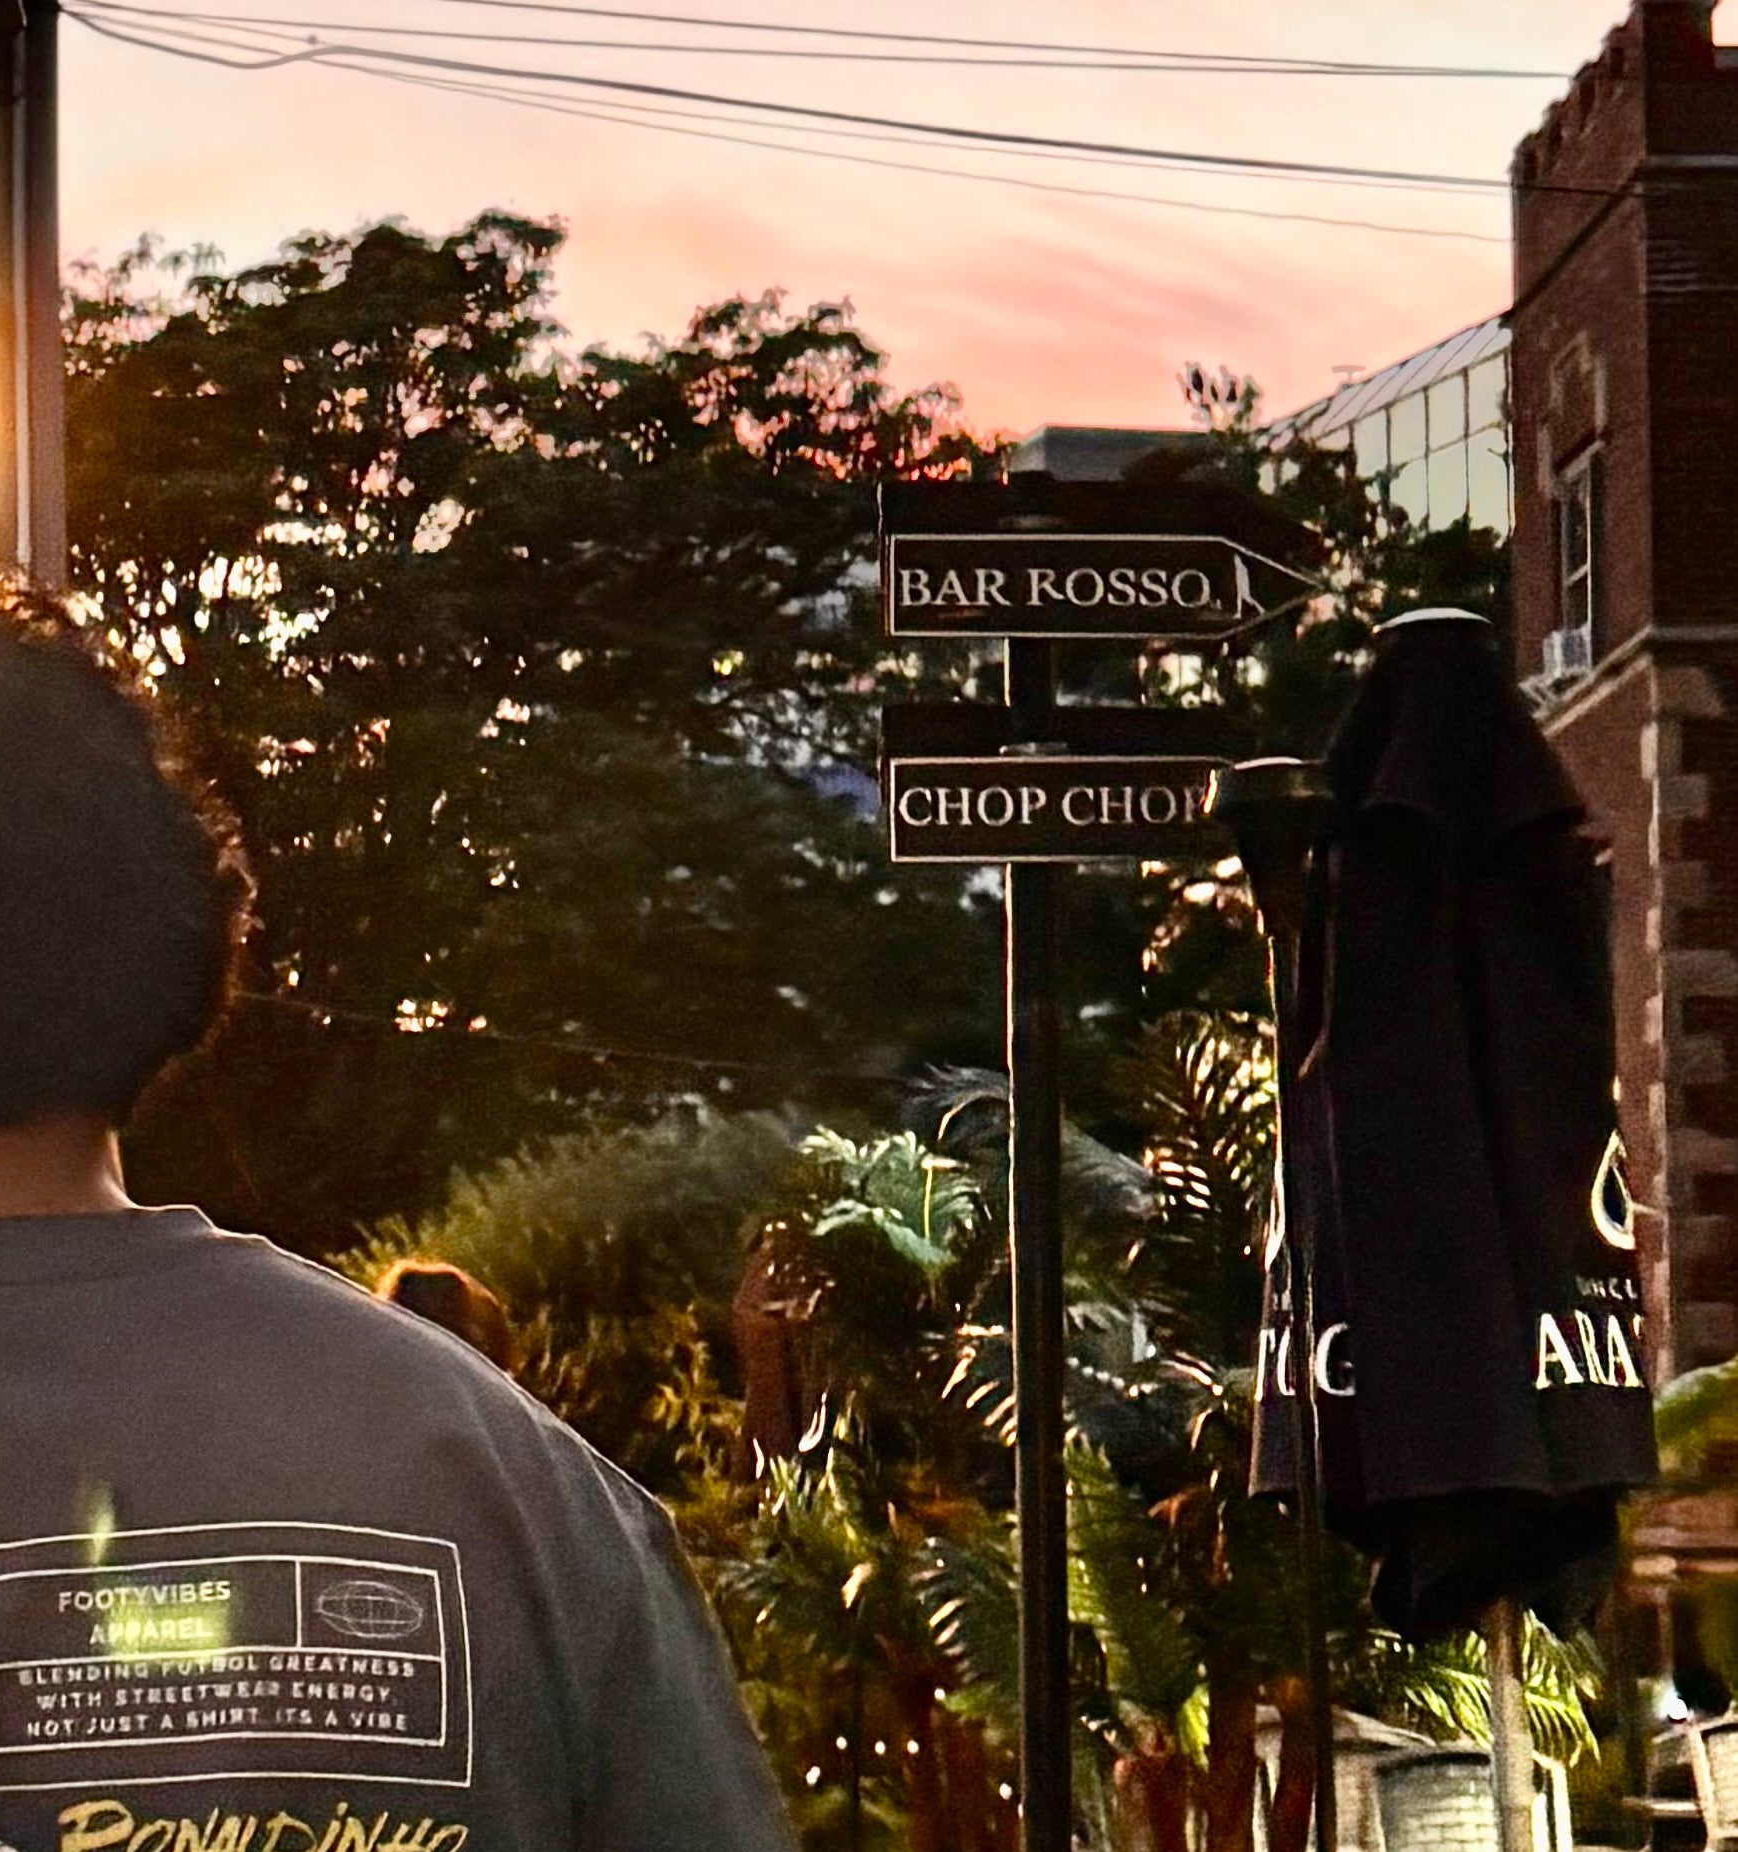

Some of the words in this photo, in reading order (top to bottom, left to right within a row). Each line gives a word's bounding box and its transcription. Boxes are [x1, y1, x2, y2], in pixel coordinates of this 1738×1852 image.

[899, 568, 1012, 607] BAR
[898, 786, 1048, 826] CHOP
[58, 1580, 232, 1612] FOOTYVIBES
[89, 1616, 217, 1645] APPAREL
[18, 1661, 149, 1686] BLENDING
[162, 1654, 260, 1679] FUTBOL
[269, 1654, 415, 1678] GREATNESS
[36, 1691, 103, 1711] WITH
[115, 1680, 281, 1706] STREETWEAR
[26, 1719, 75, 1737] NOT
[86, 1714, 150, 1735] JUST
[160, 1714, 175, 1729] A
[186, 1706, 260, 1728] SHIRT
[324, 1708, 339, 1727] A
[349, 1710, 408, 1731] VIBE
